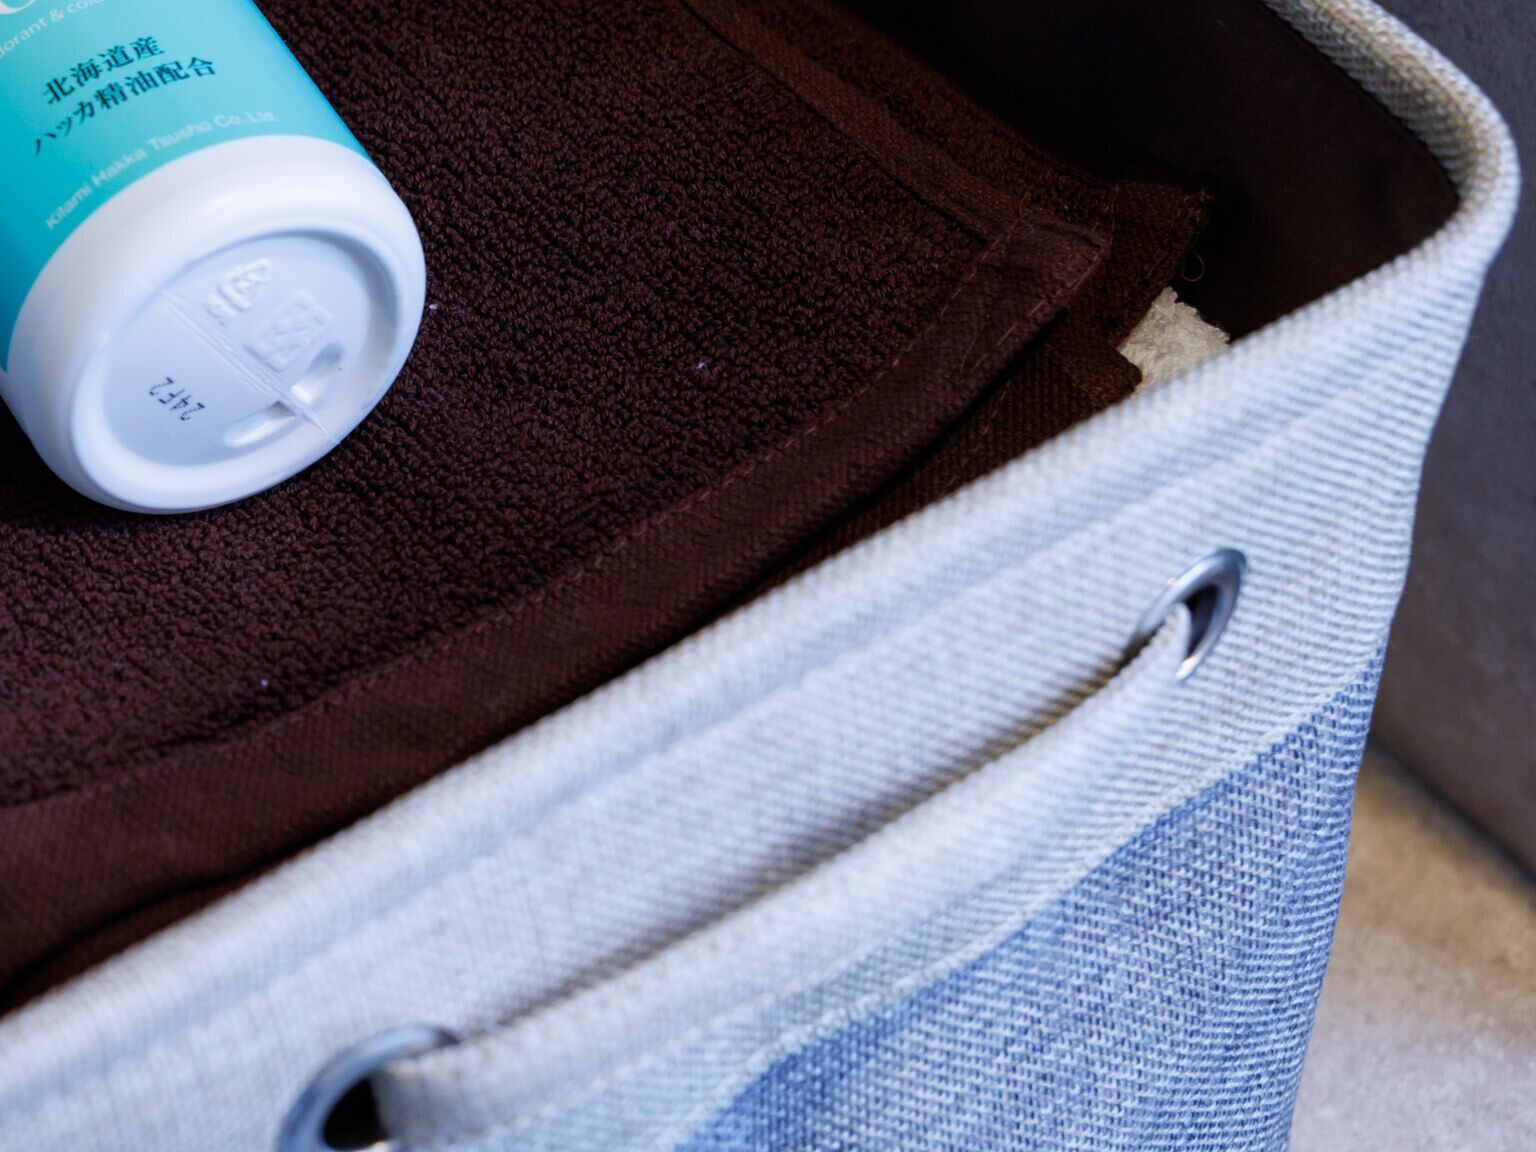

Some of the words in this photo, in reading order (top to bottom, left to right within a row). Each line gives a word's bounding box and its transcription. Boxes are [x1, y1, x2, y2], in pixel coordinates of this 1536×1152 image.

[49, 8, 65, 22] &
[43, 35, 165, 106] 北海道産
[34, 55, 216, 159] ハッカ精油配合
[46, 183, 93, 230] Kitami
[91, 149, 148, 188] Hakka
[147, 121, 213, 151] Tsusho
[148, 376, 206, 422] 24F2
